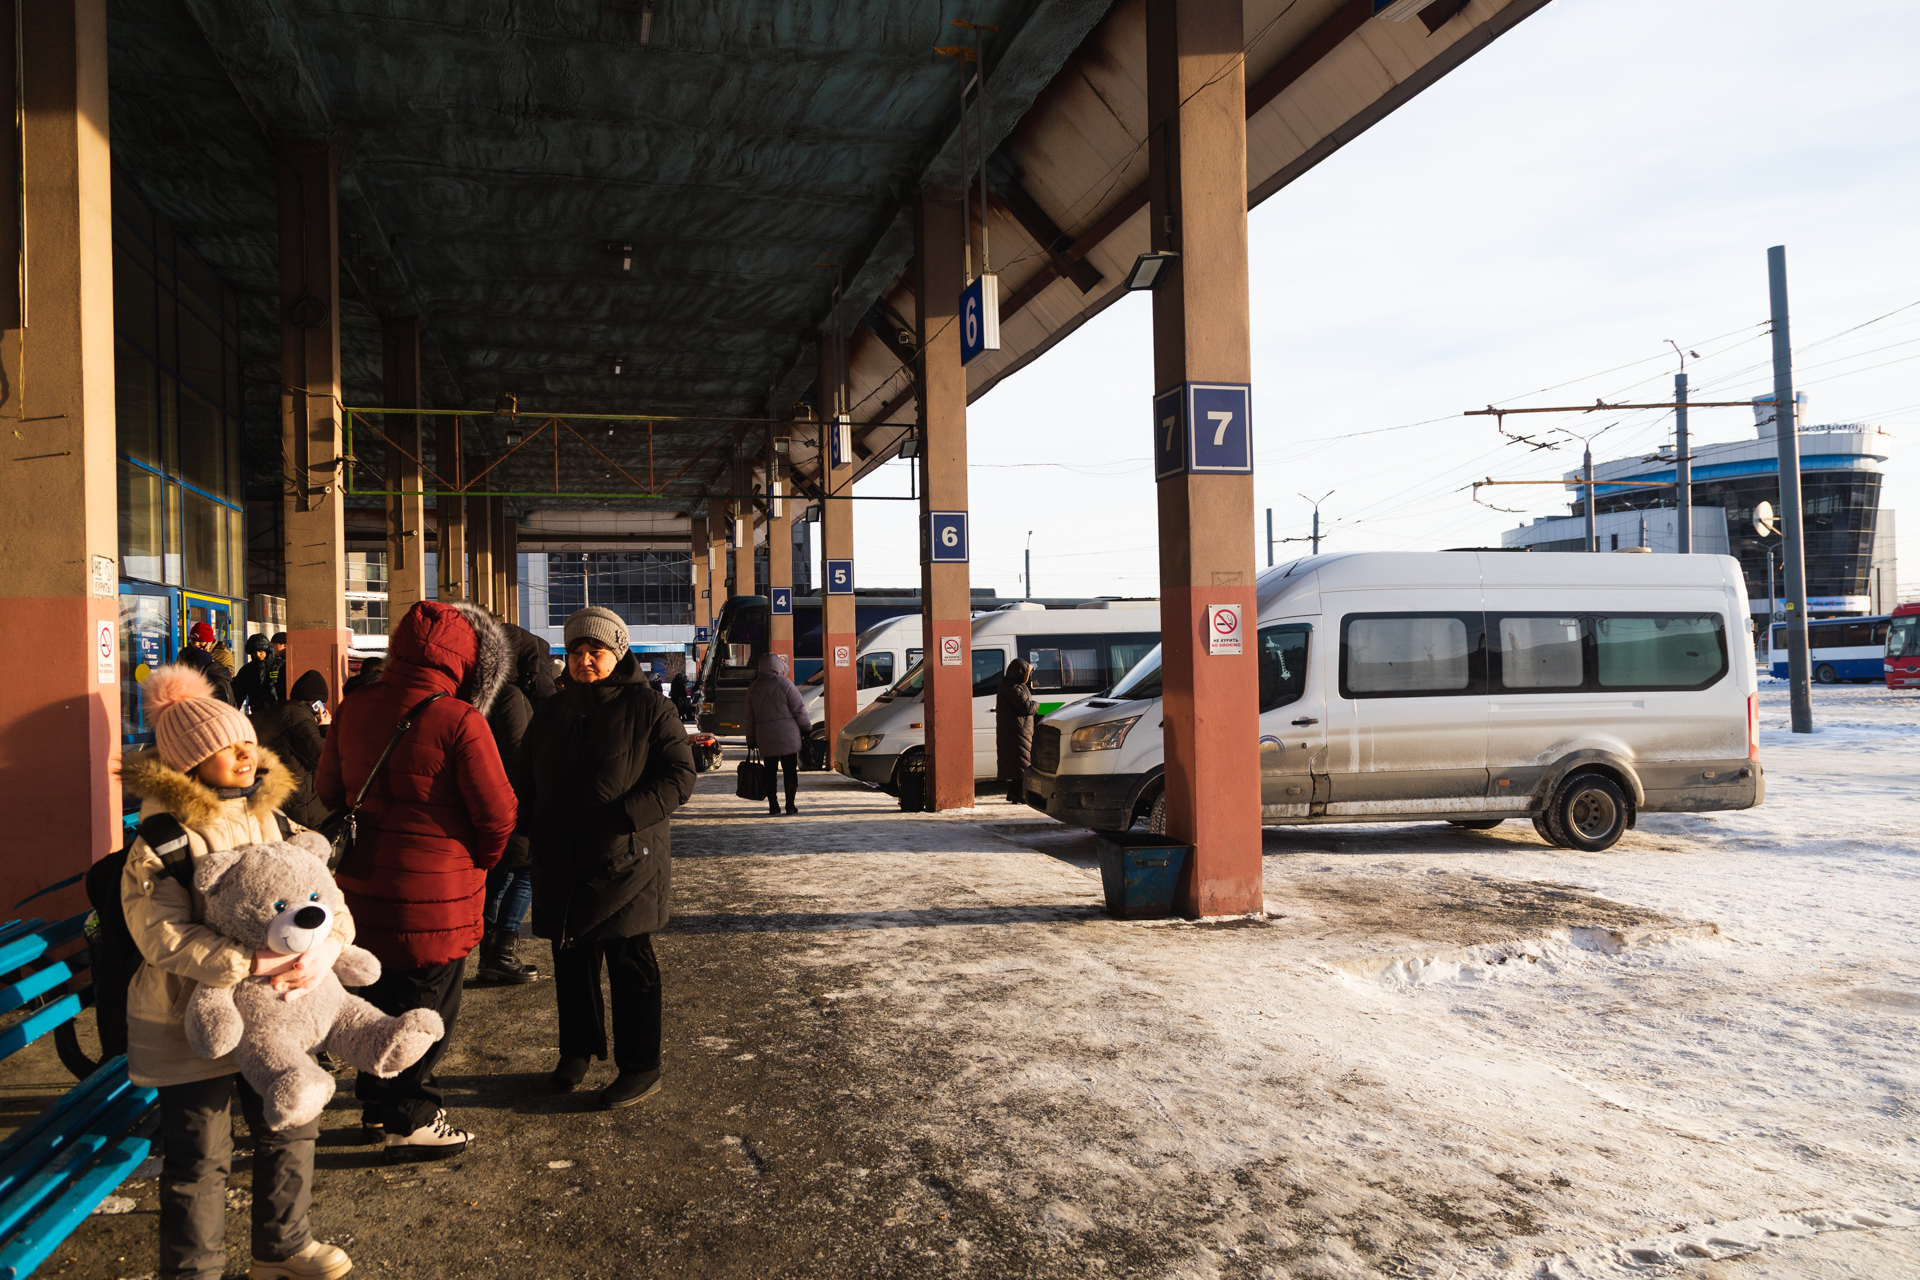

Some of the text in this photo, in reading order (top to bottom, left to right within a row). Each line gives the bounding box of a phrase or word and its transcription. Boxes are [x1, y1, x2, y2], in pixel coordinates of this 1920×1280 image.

[966, 297, 977, 347] 6
[1163, 415, 1175, 452] 7
[1207, 411, 1233, 445] 7
[833, 425, 840, 459] 5
[942, 526, 958, 547] 6
[834, 570, 847, 585] 5
[777, 595, 787, 607] 4
[700, 630, 705, 638] 1
